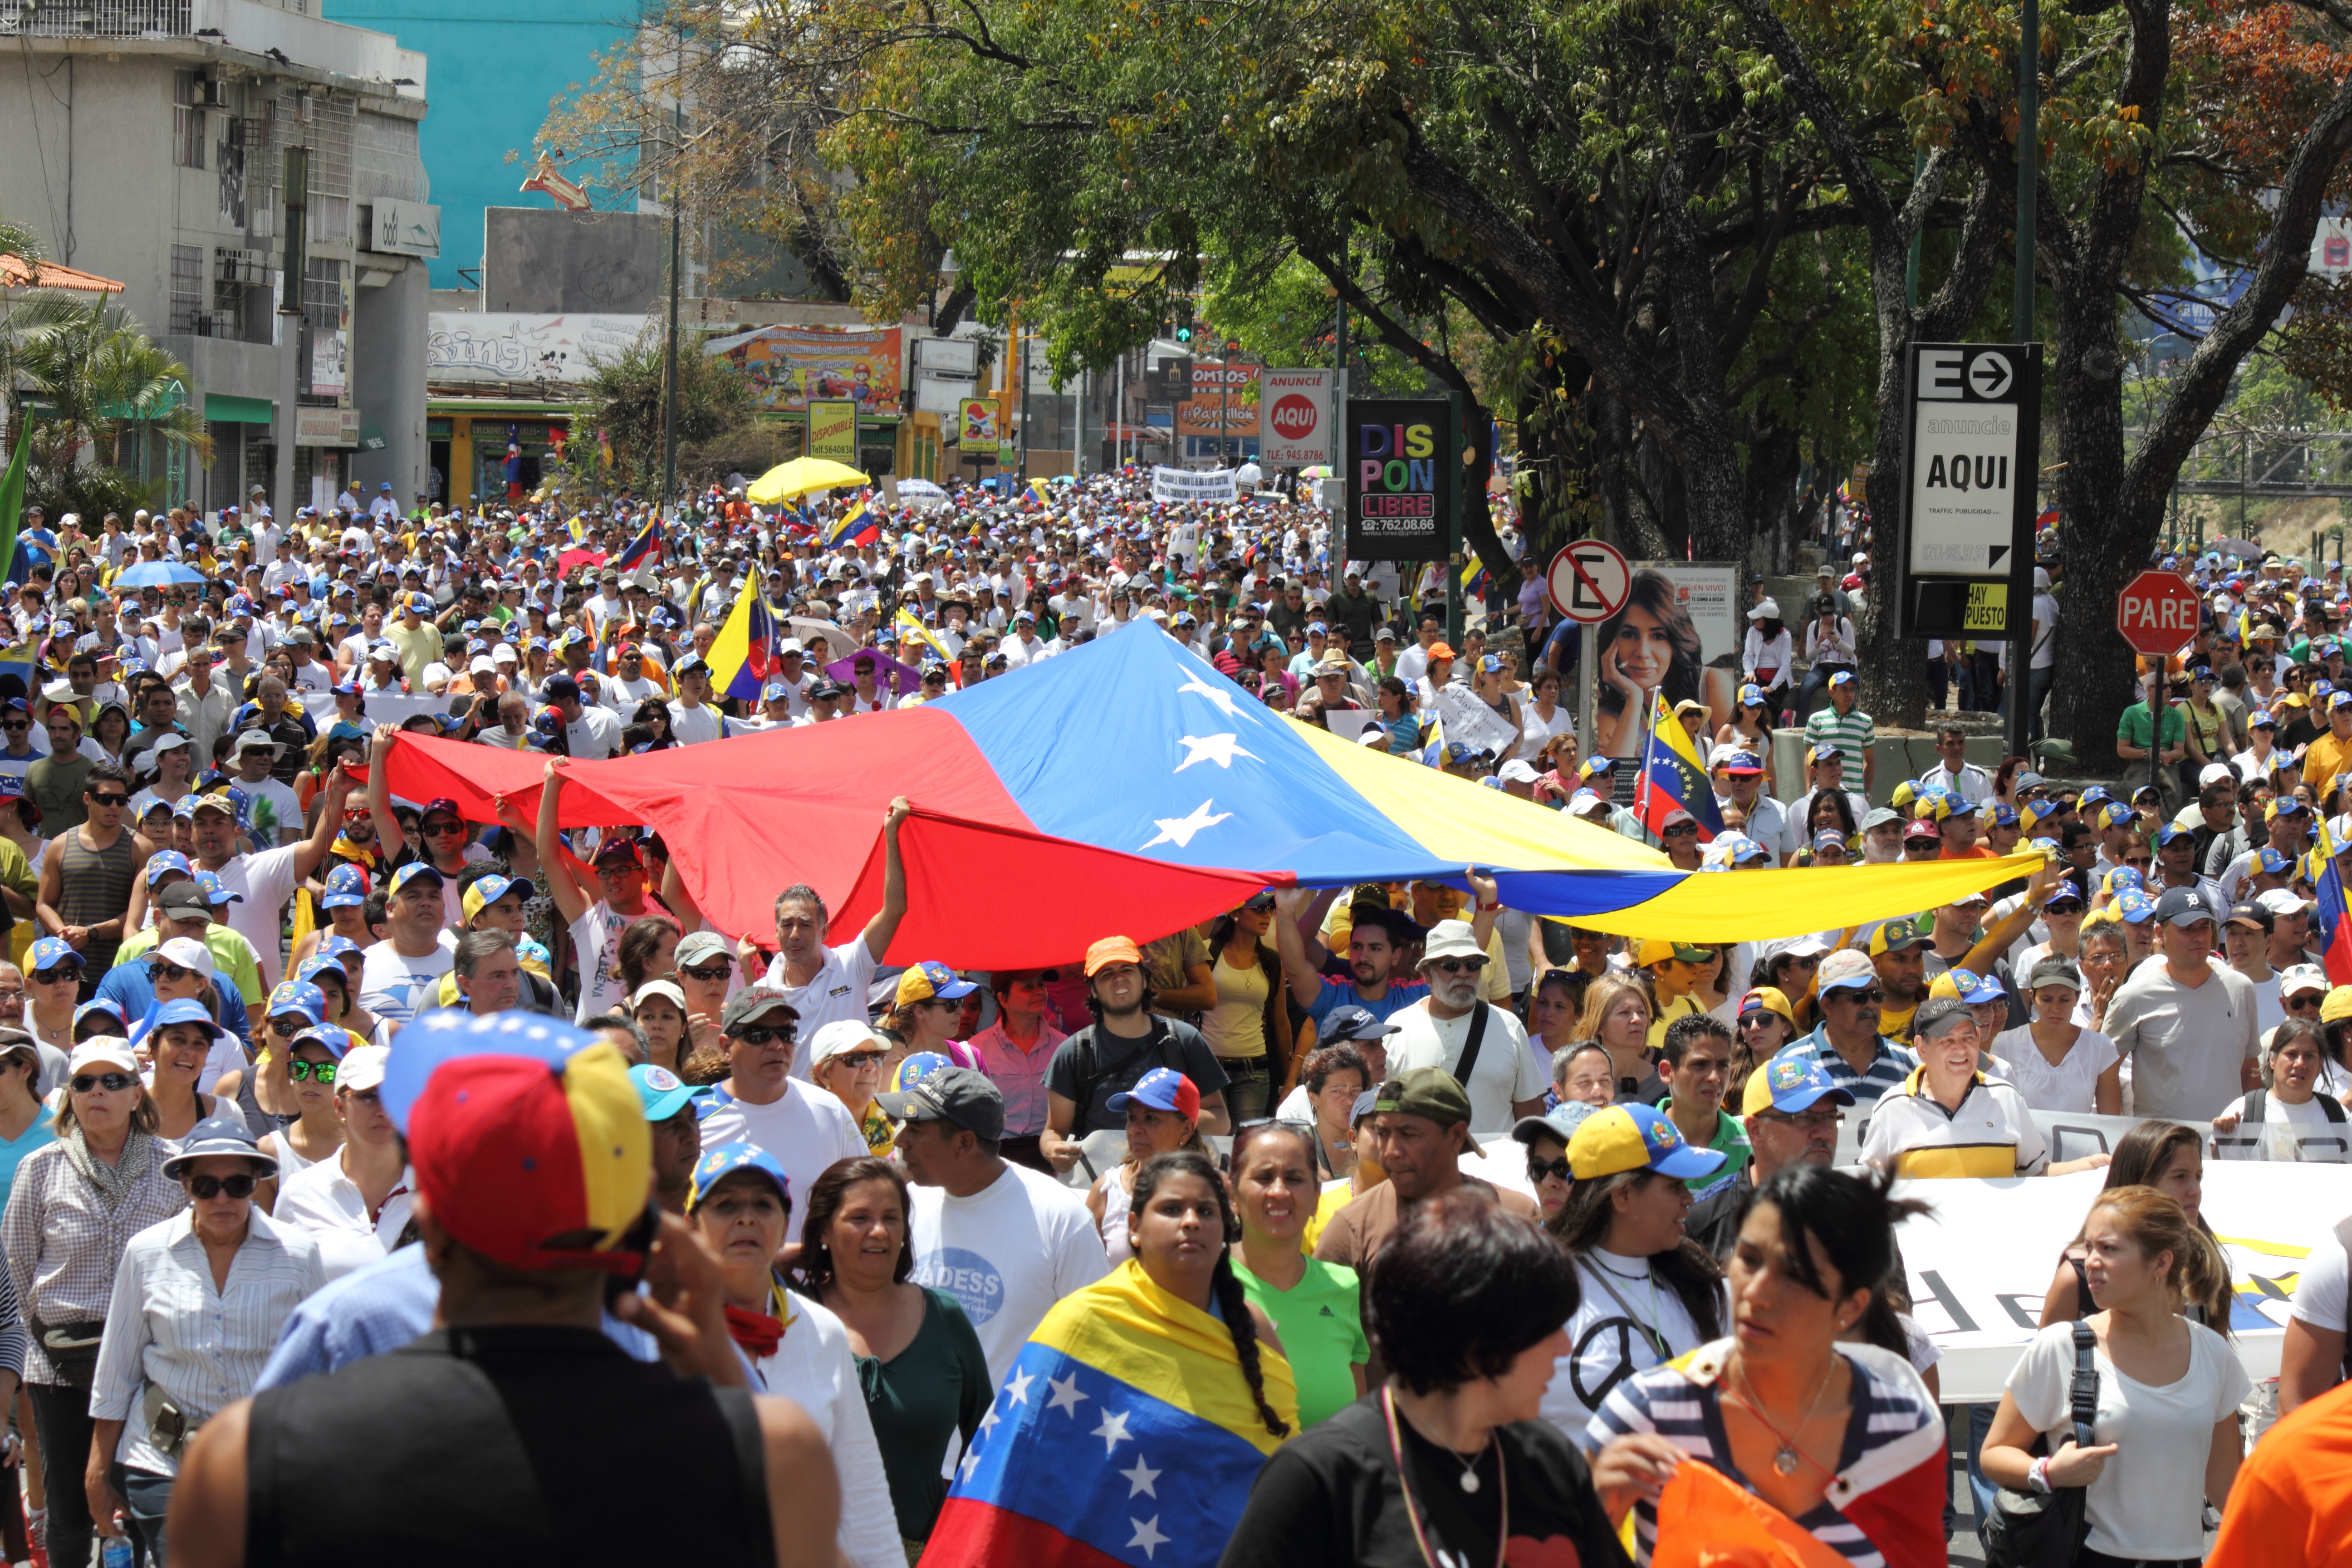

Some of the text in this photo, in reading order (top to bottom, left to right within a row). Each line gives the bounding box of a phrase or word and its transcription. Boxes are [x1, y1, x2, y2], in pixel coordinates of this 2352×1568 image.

[761, 331, 779, 340] FERIA
[779, 331, 789, 340] DE
[820, 333, 838, 342] PARA
[859, 333, 864, 342] Y
[769, 344, 788, 353] GRAN
[789, 345, 822, 355] VARIEDAD
[822, 346, 832, 355] DE
[806, 360, 811, 368] A
[1192, 368, 1248, 384] OMBOS
[1270, 377, 1322, 387] ANUNCIE
[1917, 350, 1964, 398] E
[1183, 409, 1191, 419] El
[1273, 407, 1315, 427] AQUI
[301, 420, 340, 436] COPACABANA
[473, 426, 536, 436] COLCHONES IABLES
[812, 418, 853, 443] DISPONIBLE
[1927, 415, 2010, 435] anuncie
[812, 445, 853, 454] Telf.5640838
[1361, 424, 1434, 458] DIS
[1266, 450, 1324, 460] TLF.: 945.8786
[1361, 459, 1434, 492] PON
[1926, 454, 2008, 493] AQUI
[1364, 496, 1431, 516] LIBRE
[1922, 544, 1986, 562] 0212-985.97.97
[1968, 586, 1988, 605] HAY
[1965, 607, 2004, 626] PUESTO
[2123, 596, 2196, 630] PARE
[95, 1036, 111, 1048] W
